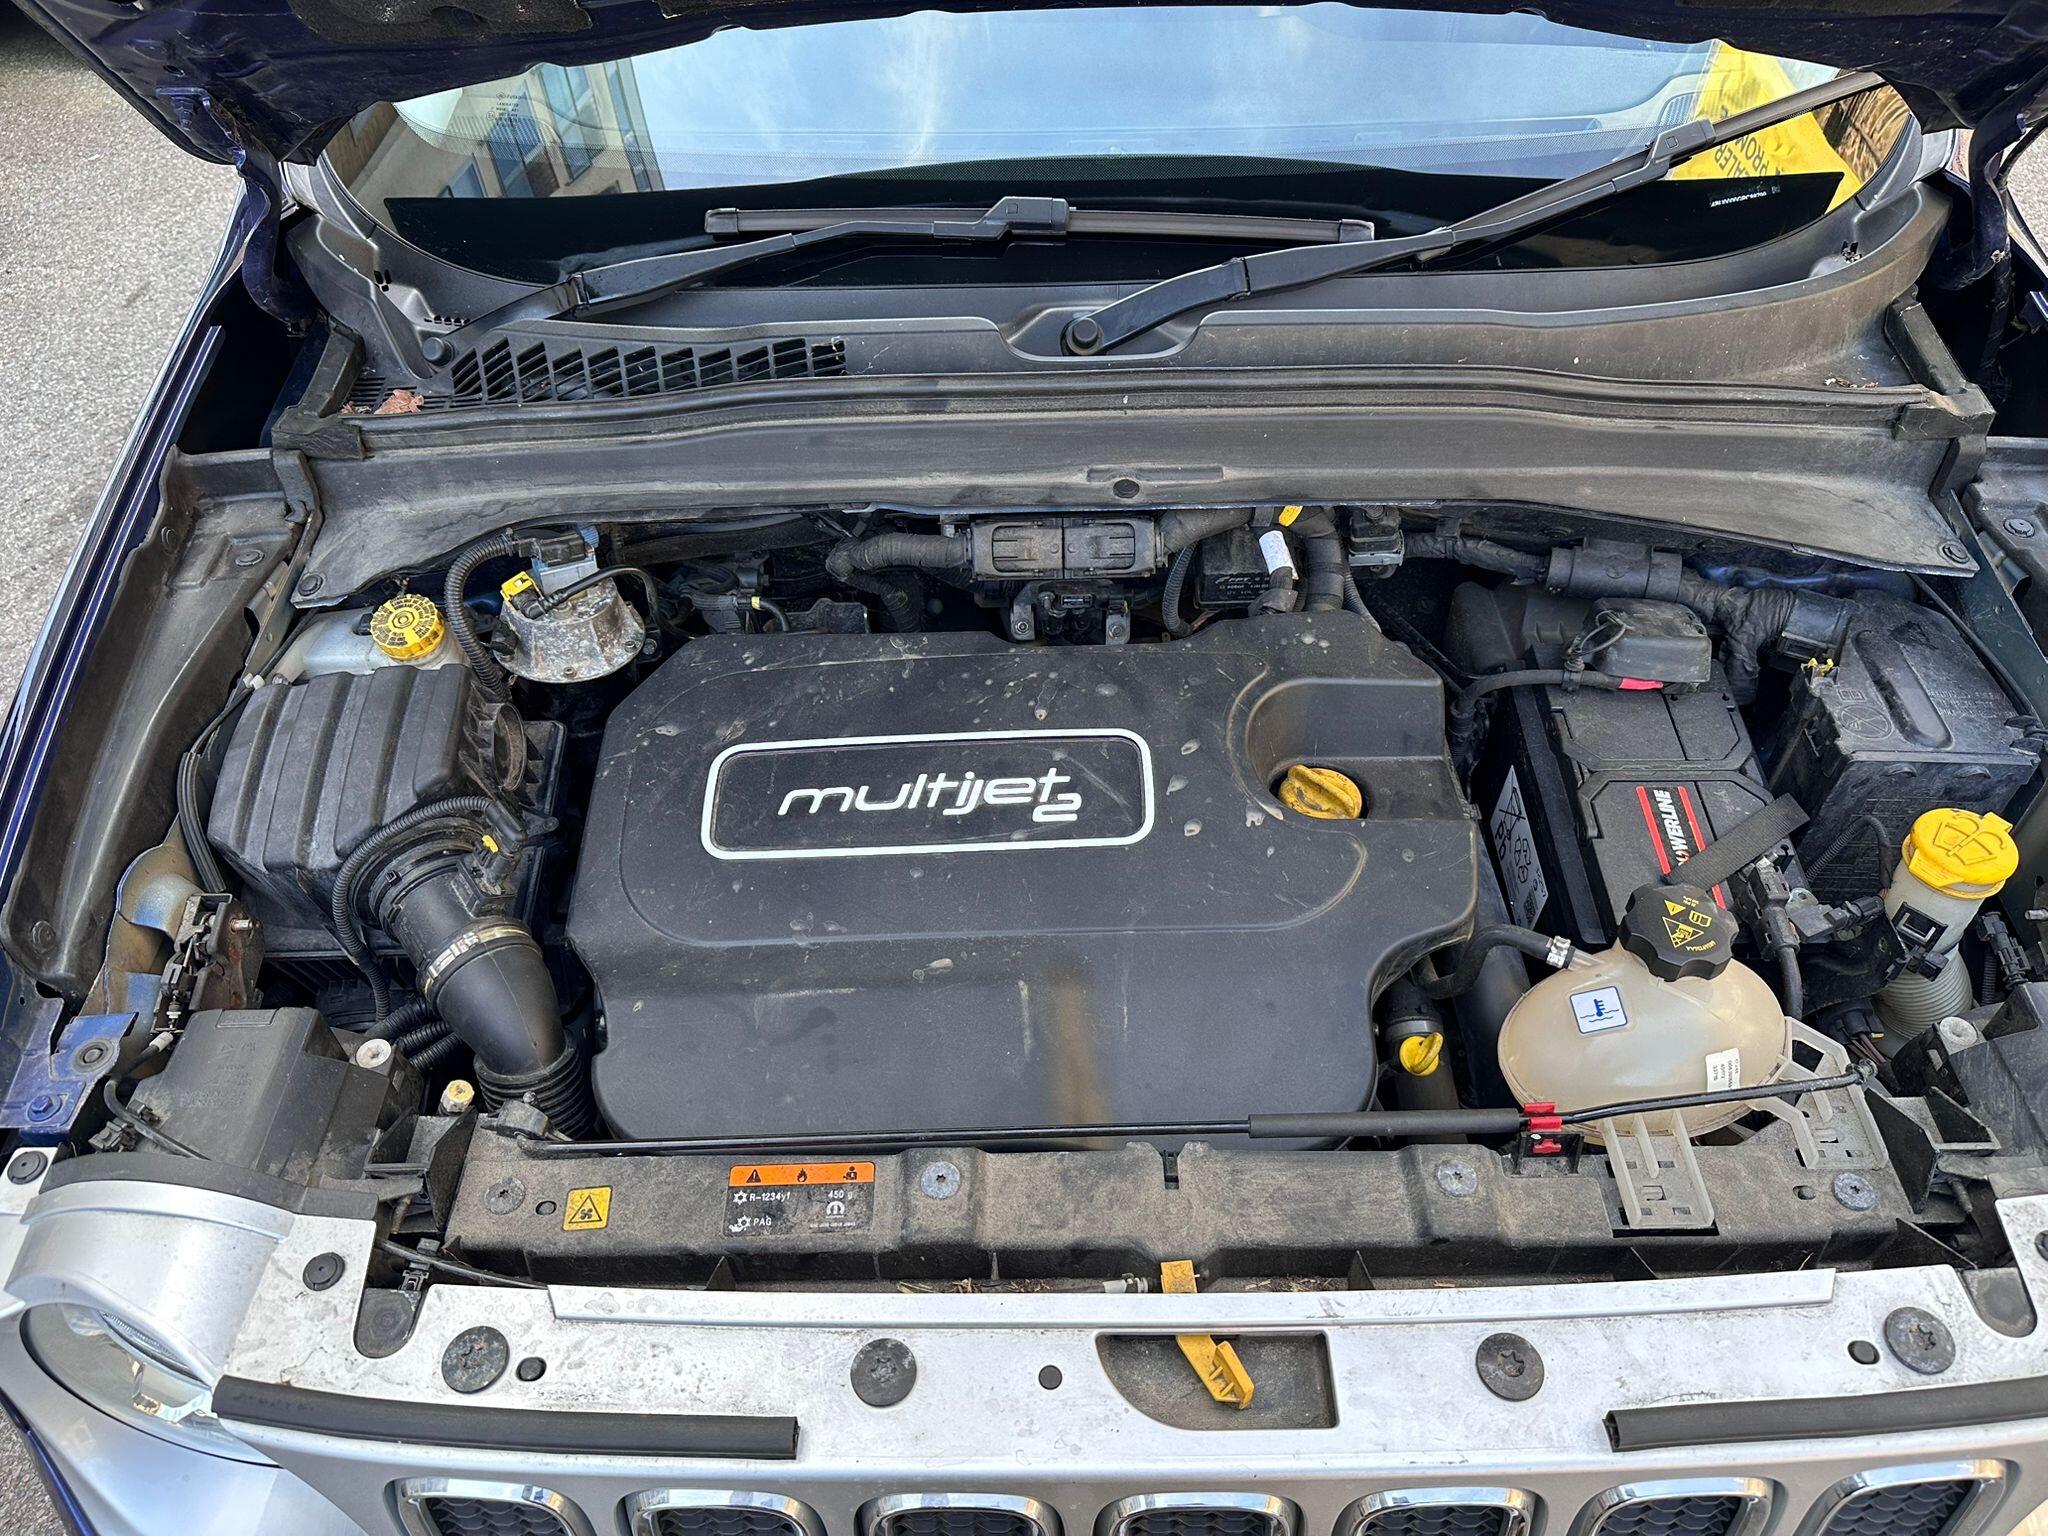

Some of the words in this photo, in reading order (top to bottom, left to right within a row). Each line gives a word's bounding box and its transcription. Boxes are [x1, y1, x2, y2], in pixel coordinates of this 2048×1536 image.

[1714, 144, 1750, 178] ALER
[1653, 789, 1690, 866] OWERLINE
[828, 1190, 845, 1199] 450
[753, 1217, 772, 1226] PAG
